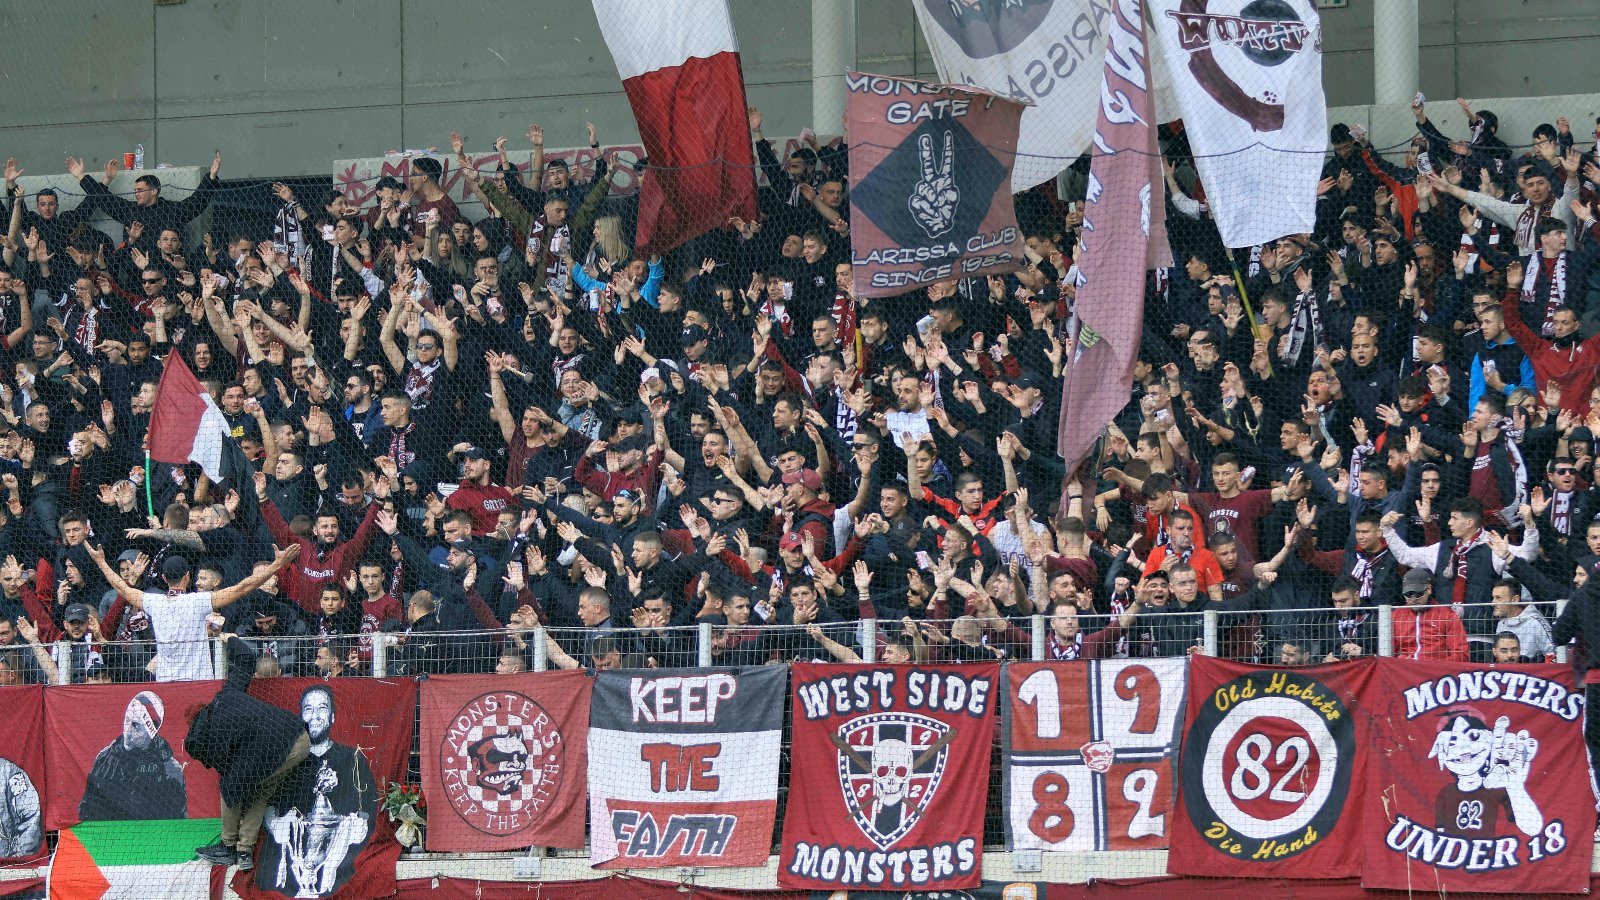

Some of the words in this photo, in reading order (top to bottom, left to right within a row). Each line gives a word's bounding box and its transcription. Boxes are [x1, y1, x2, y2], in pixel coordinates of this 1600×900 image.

[886, 99, 971, 124] GATE
[851, 242, 960, 265] LARISSA
[966, 227, 1017, 252] CLUB
[871, 265, 952, 288] SINCE
[961, 253, 1013, 274] 1982
[303, 566, 334, 578] MONSTERS
[630, 673, 737, 724] KEEP
[799, 670, 895, 718] WEST
[908, 671, 989, 716] SIDE
[1018, 669, 1061, 738] 1
[1114, 664, 1161, 734] 9
[1215, 679, 1257, 712] Old
[1264, 672, 1341, 721] Habits
[1404, 671, 1585, 720] MONSTERS
[447, 694, 561, 754] MONSTERS
[641, 742, 721, 793] THE
[1230, 733, 1310, 803] 82
[444, 767, 479, 816] KEEP
[485, 812, 520, 830] THE
[523, 763, 559, 820] FAITH
[1456, 800, 1484, 830] 82
[610, 809, 738, 858] FAITH
[1204, 821, 1243, 854] Die
[1386, 816, 1520, 871] UNDER
[1528, 822, 1567, 862] 18
[791, 837, 975, 885] MONSTERS
